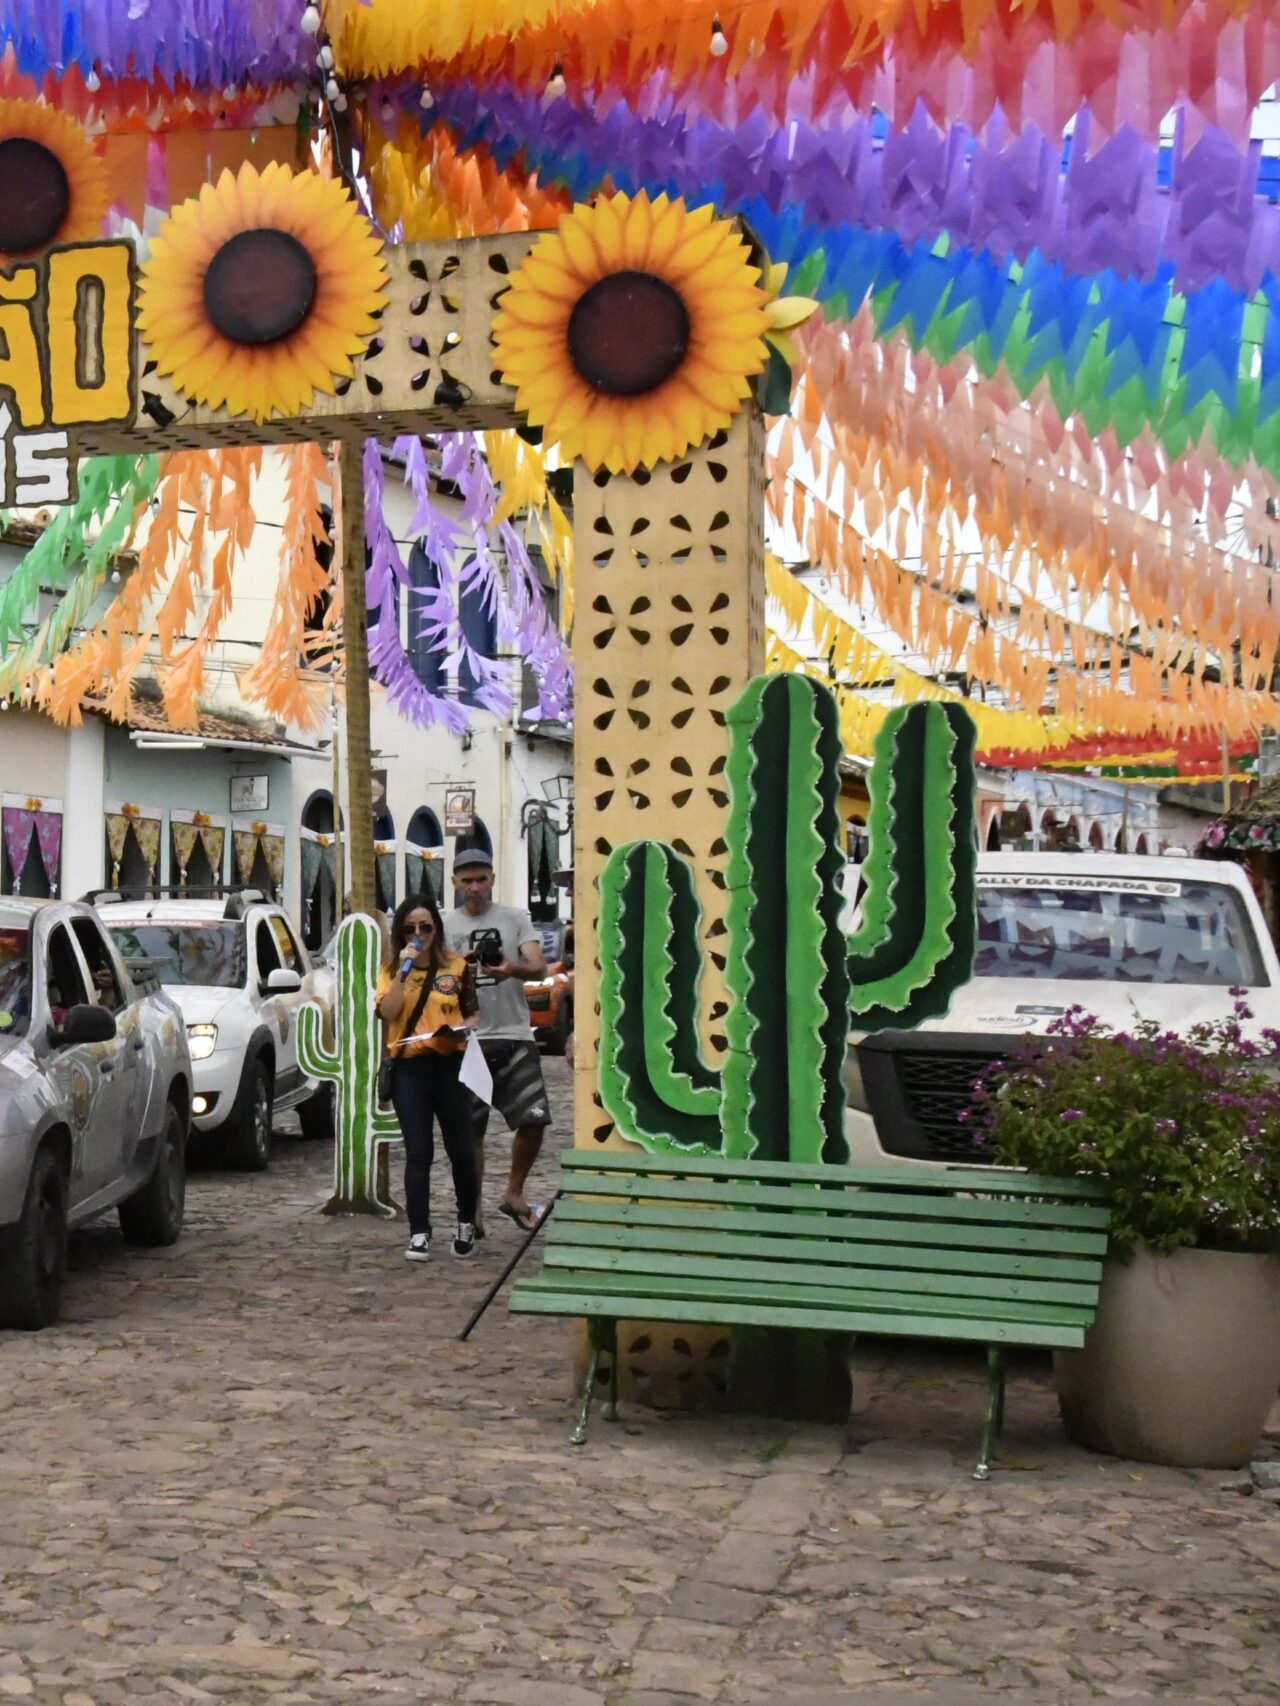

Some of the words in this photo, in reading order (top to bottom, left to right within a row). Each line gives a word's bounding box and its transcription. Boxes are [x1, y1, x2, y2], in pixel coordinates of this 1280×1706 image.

[977, 876, 1023, 886] ALLY
[1026, 877, 1051, 887] DA
[1054, 879, 1149, 892] CHAPADA
